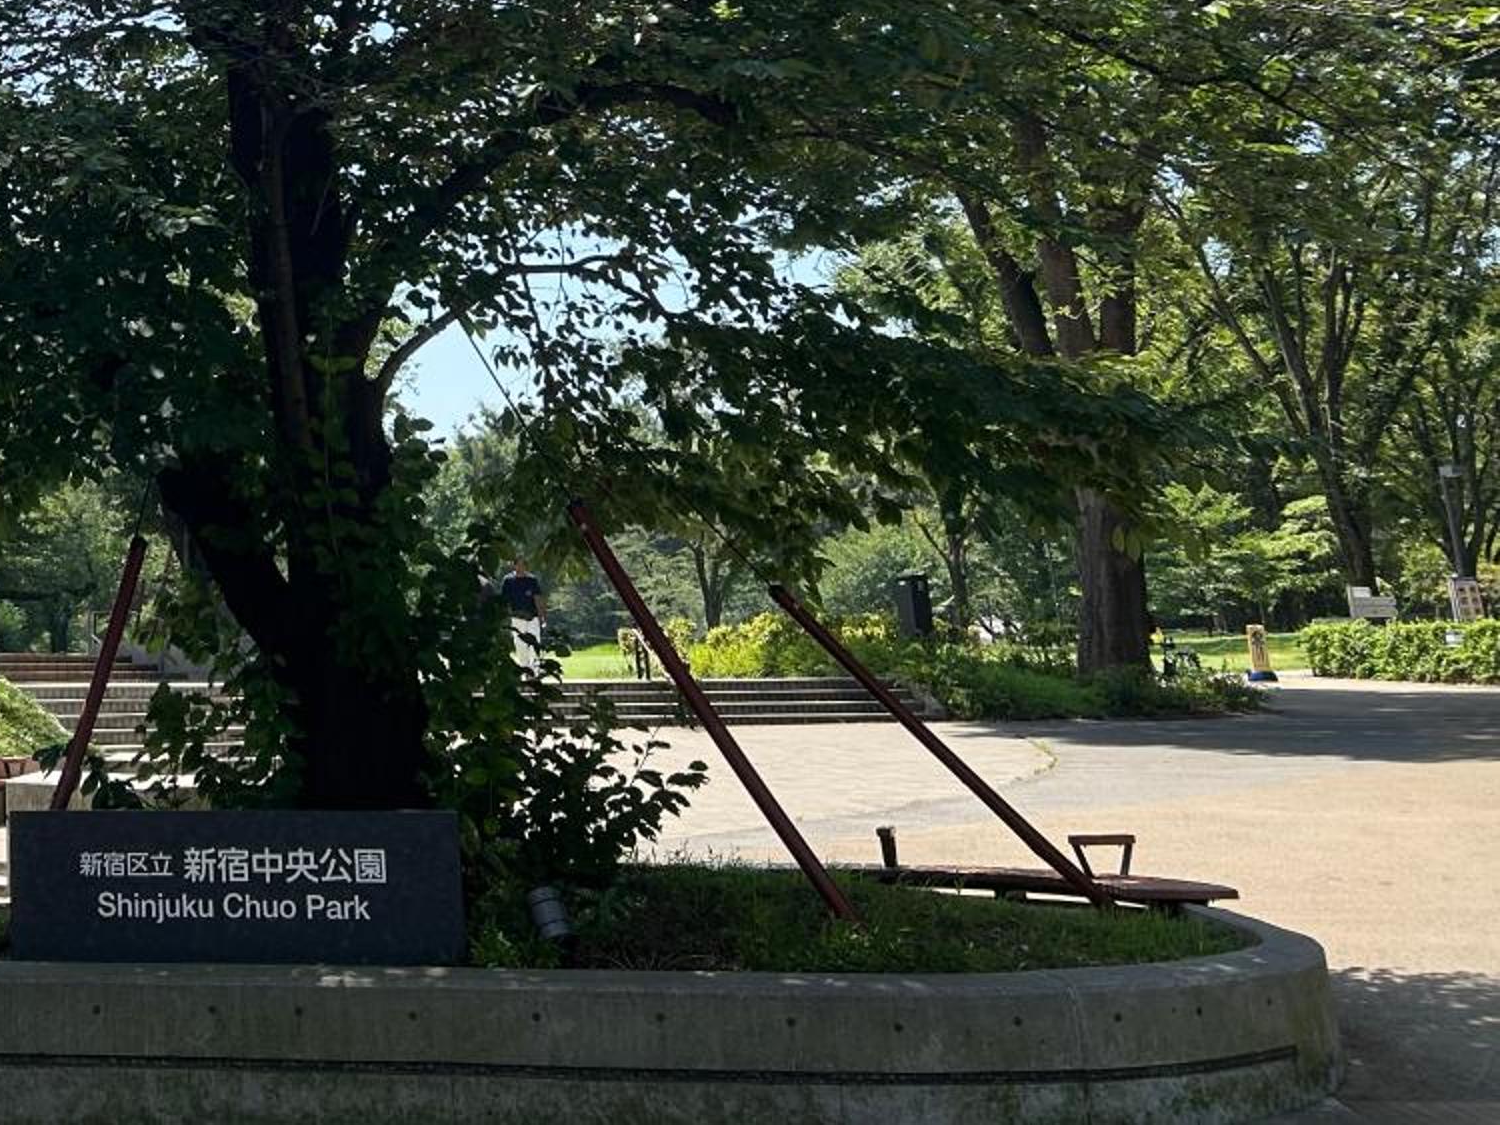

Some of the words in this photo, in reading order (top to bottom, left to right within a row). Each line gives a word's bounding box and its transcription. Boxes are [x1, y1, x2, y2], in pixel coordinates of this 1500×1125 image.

[79, 851, 173, 876] 新宿区立
[183, 847, 387, 884] 新宿中央公園
[98, 892, 214, 923] Shinjuku
[223, 892, 296, 919] Chuo
[306, 894, 371, 920] Park
